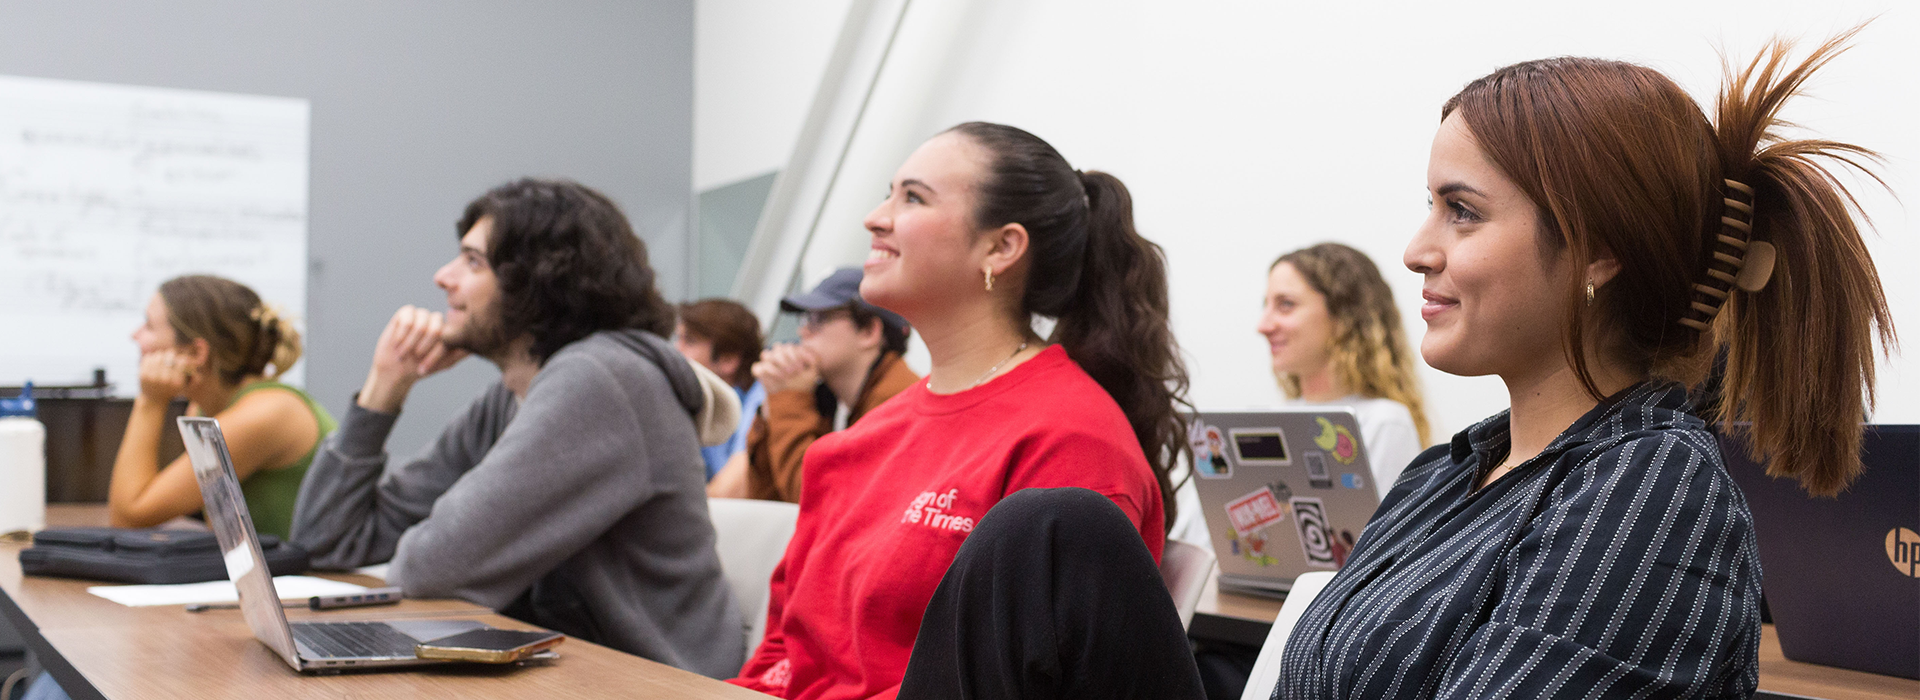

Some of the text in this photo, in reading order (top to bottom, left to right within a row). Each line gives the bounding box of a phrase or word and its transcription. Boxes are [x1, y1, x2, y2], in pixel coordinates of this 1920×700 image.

[936, 488, 958, 510] of
[924, 507, 974, 533] Times
[1894, 527, 1920, 578] hp
